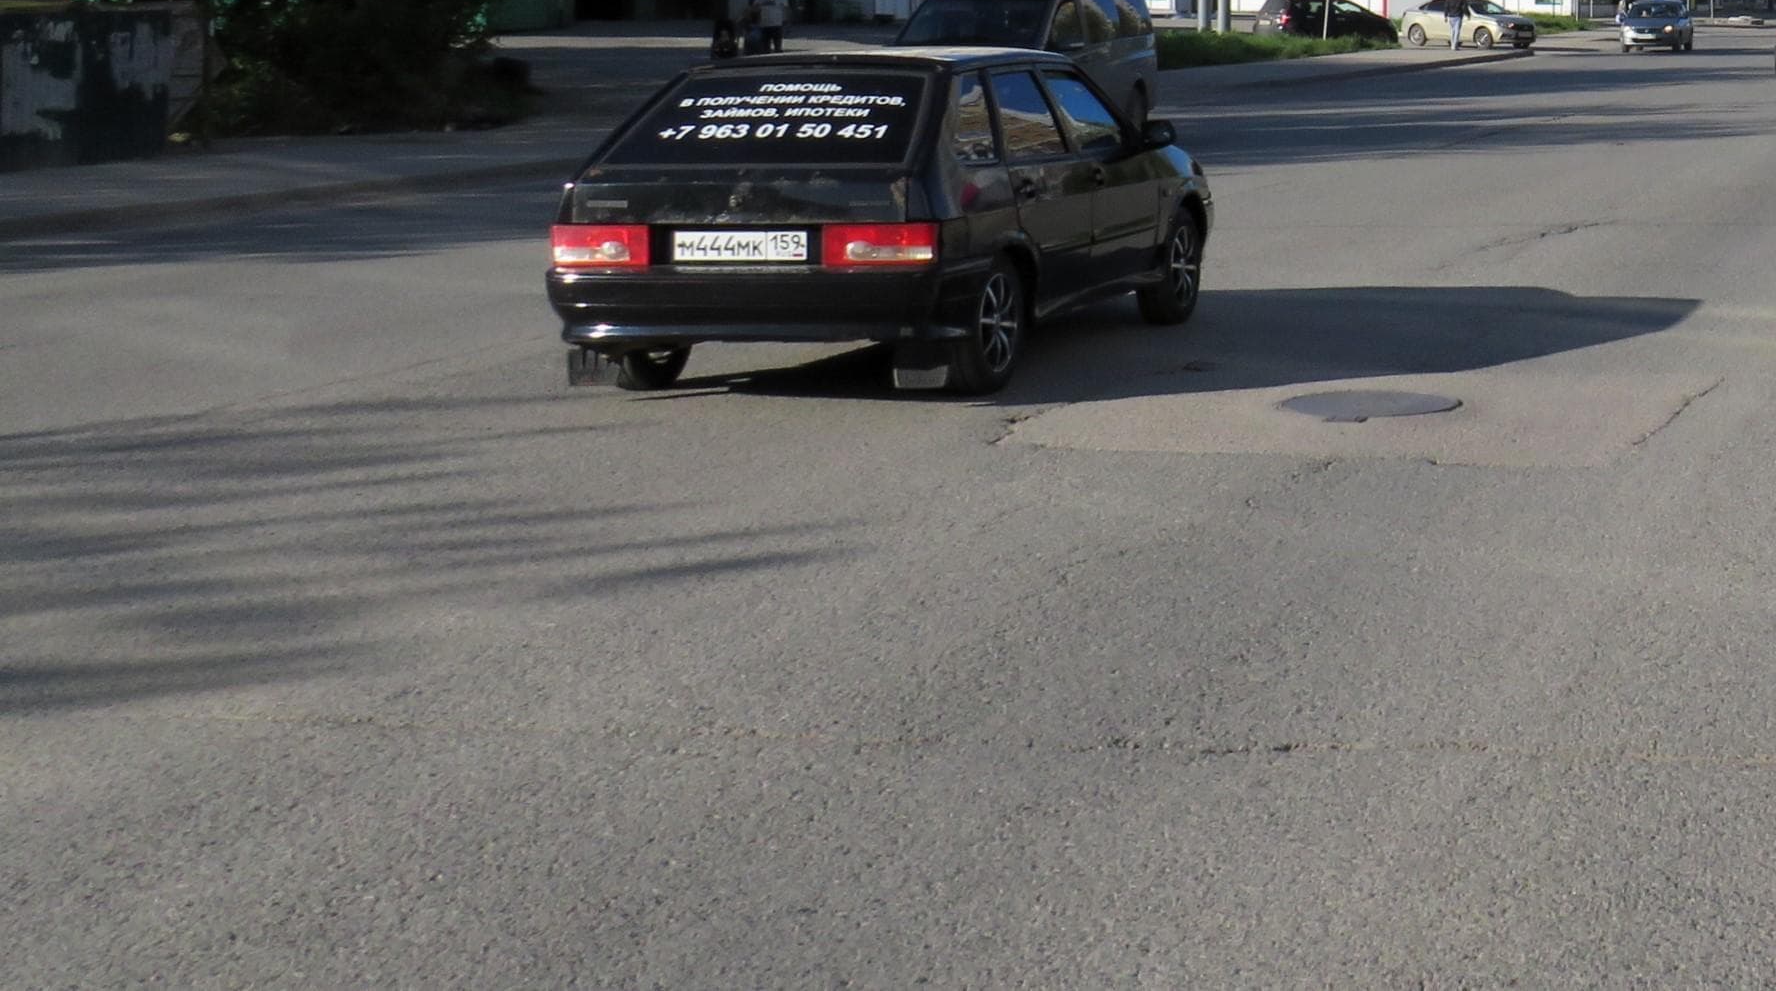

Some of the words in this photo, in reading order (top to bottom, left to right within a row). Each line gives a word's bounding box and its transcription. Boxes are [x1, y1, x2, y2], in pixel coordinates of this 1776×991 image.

[759, 83, 842, 93] ПОМОЩЬ
[680, 98, 695, 108] В
[696, 95, 805, 107] ПОЛУЧЕНИИ
[807, 95, 906, 108] КРЕДИТОВ,
[700, 107, 780, 119] ЗАЙМОВ,
[784, 107, 870, 118] ИПОТЕКИ
[658, 125, 695, 141] +7
[698, 124, 750, 139] 963
[755, 123, 790, 139] 01
[795, 123, 833, 139] 50
[837, 124, 889, 140] 451
[770, 234, 802, 250] 159
